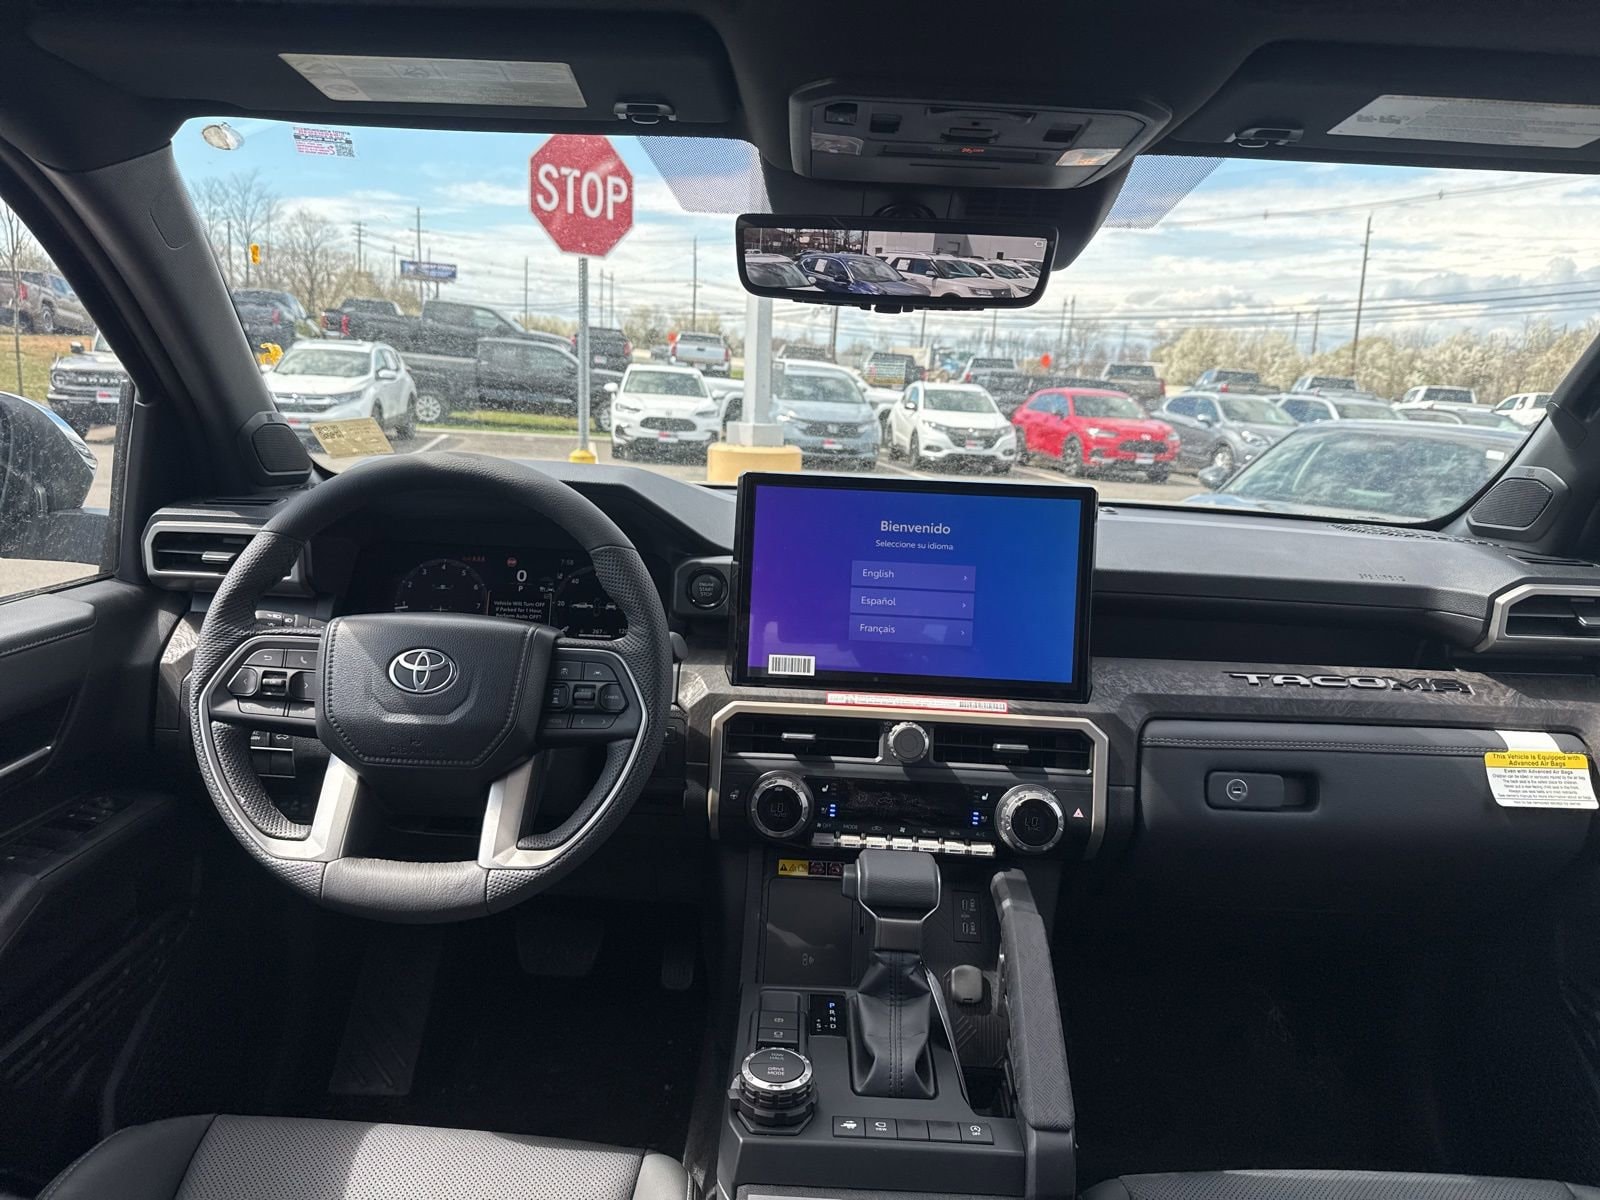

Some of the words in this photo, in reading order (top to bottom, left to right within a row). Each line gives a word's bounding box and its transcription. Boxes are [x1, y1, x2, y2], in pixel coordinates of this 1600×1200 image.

[536, 163, 628, 220] STOP
[881, 520, 951, 534] Bienvenido
[875, 539, 916, 549] Seleccione
[927, 542, 954, 550] idioma
[516, 570, 527, 583] 0
[862, 568, 895, 580] English
[518, 585, 524, 593] P
[861, 595, 896, 606] Español
[859, 623, 896, 634] Français
[1223, 671, 1474, 695] TACOMA
